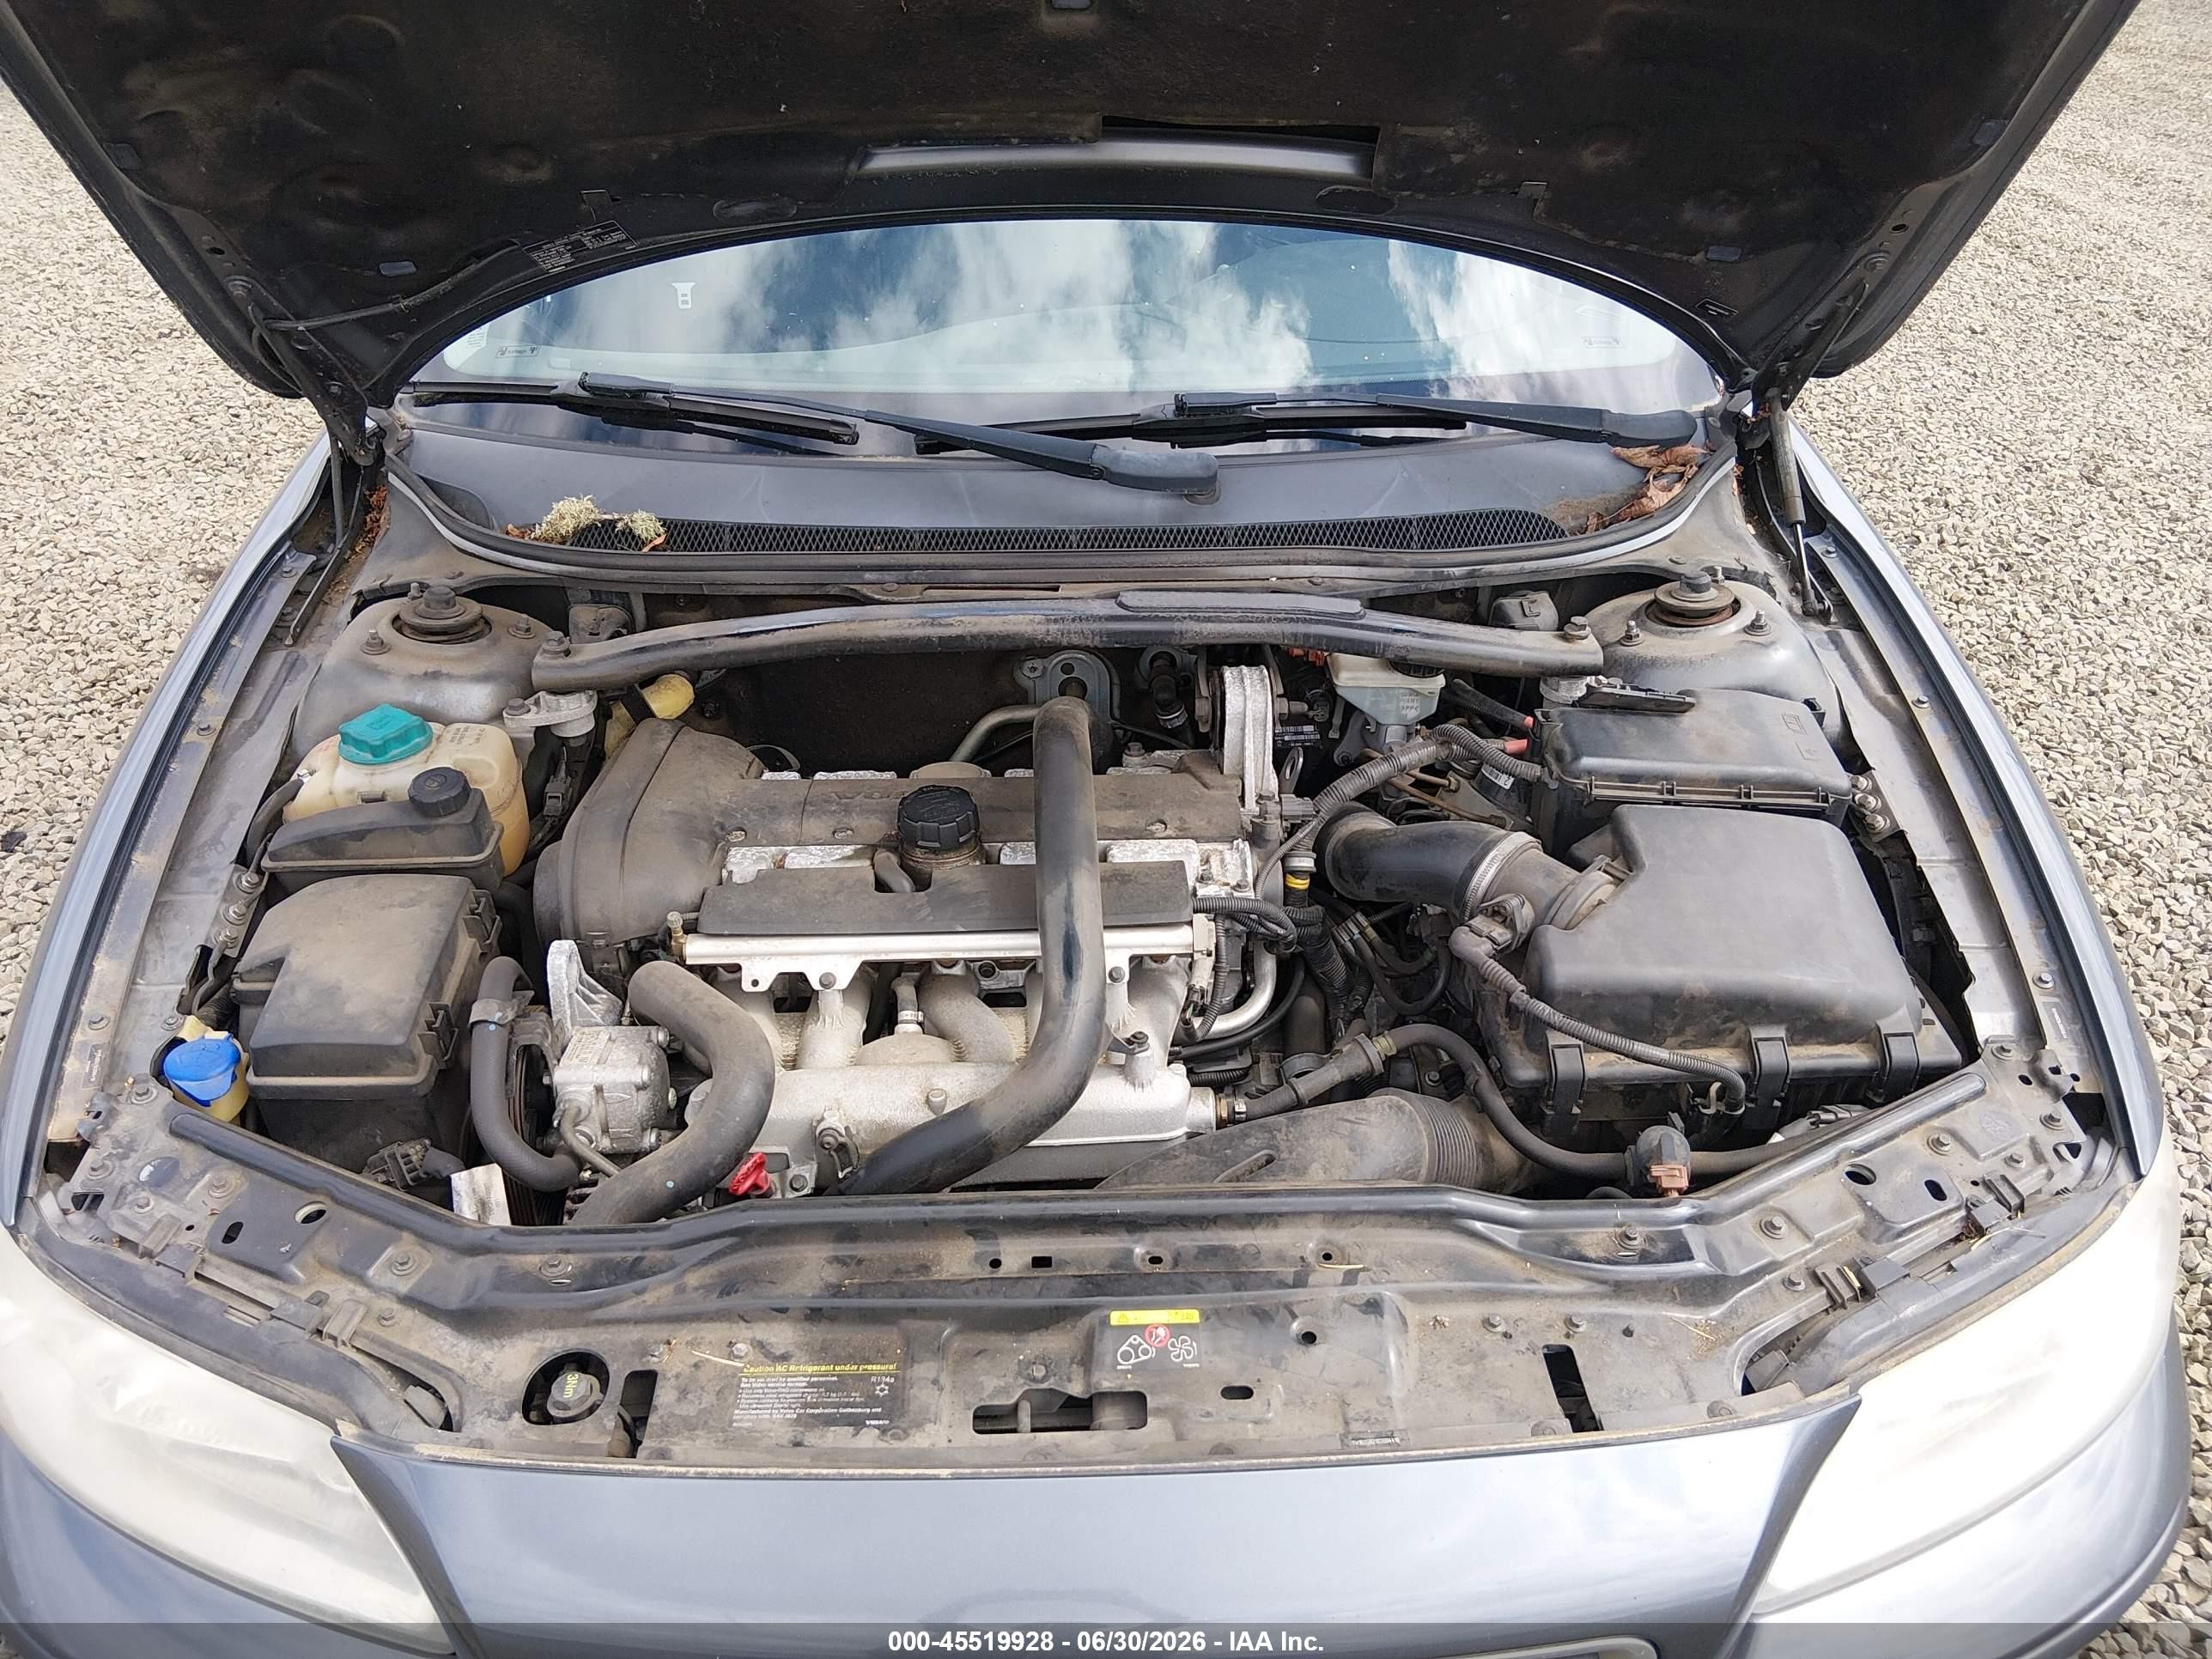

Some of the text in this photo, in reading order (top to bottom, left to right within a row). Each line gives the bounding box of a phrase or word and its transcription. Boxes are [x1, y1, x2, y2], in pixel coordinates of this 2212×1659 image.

[744, 1364, 775, 1373] Caution
[790, 1364, 834, 1374] Refrigerant
[835, 1363, 859, 1371] under
[563, 1374, 579, 1399] 3Nm
